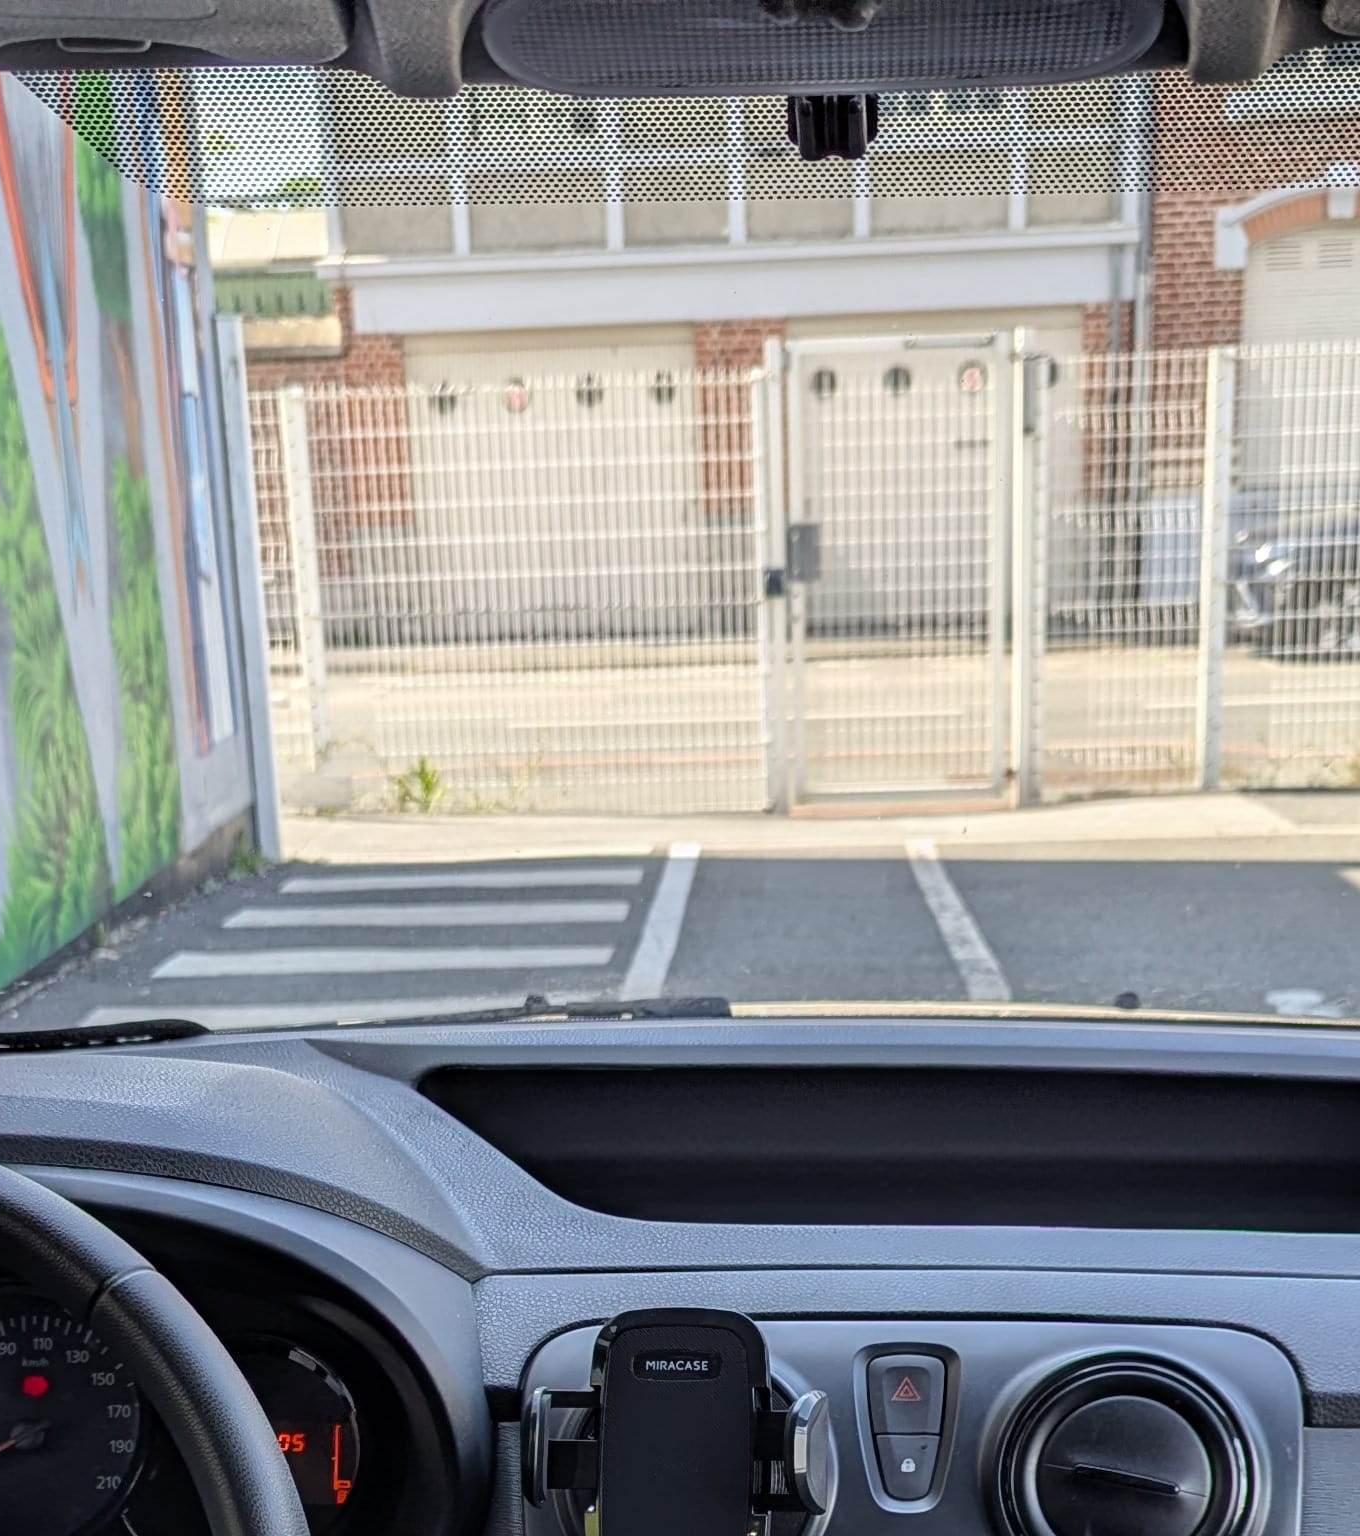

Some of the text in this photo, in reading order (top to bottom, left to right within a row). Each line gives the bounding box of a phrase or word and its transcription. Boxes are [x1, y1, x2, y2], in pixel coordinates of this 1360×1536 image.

[66, 1350, 89, 1364] 130
[645, 1360, 709, 1371] MIRACASE
[91, 1372, 115, 1386] 150
[107, 1404, 131, 1418] 170
[109, 1439, 134, 1454] 190
[95, 1475, 122, 1490] 210
